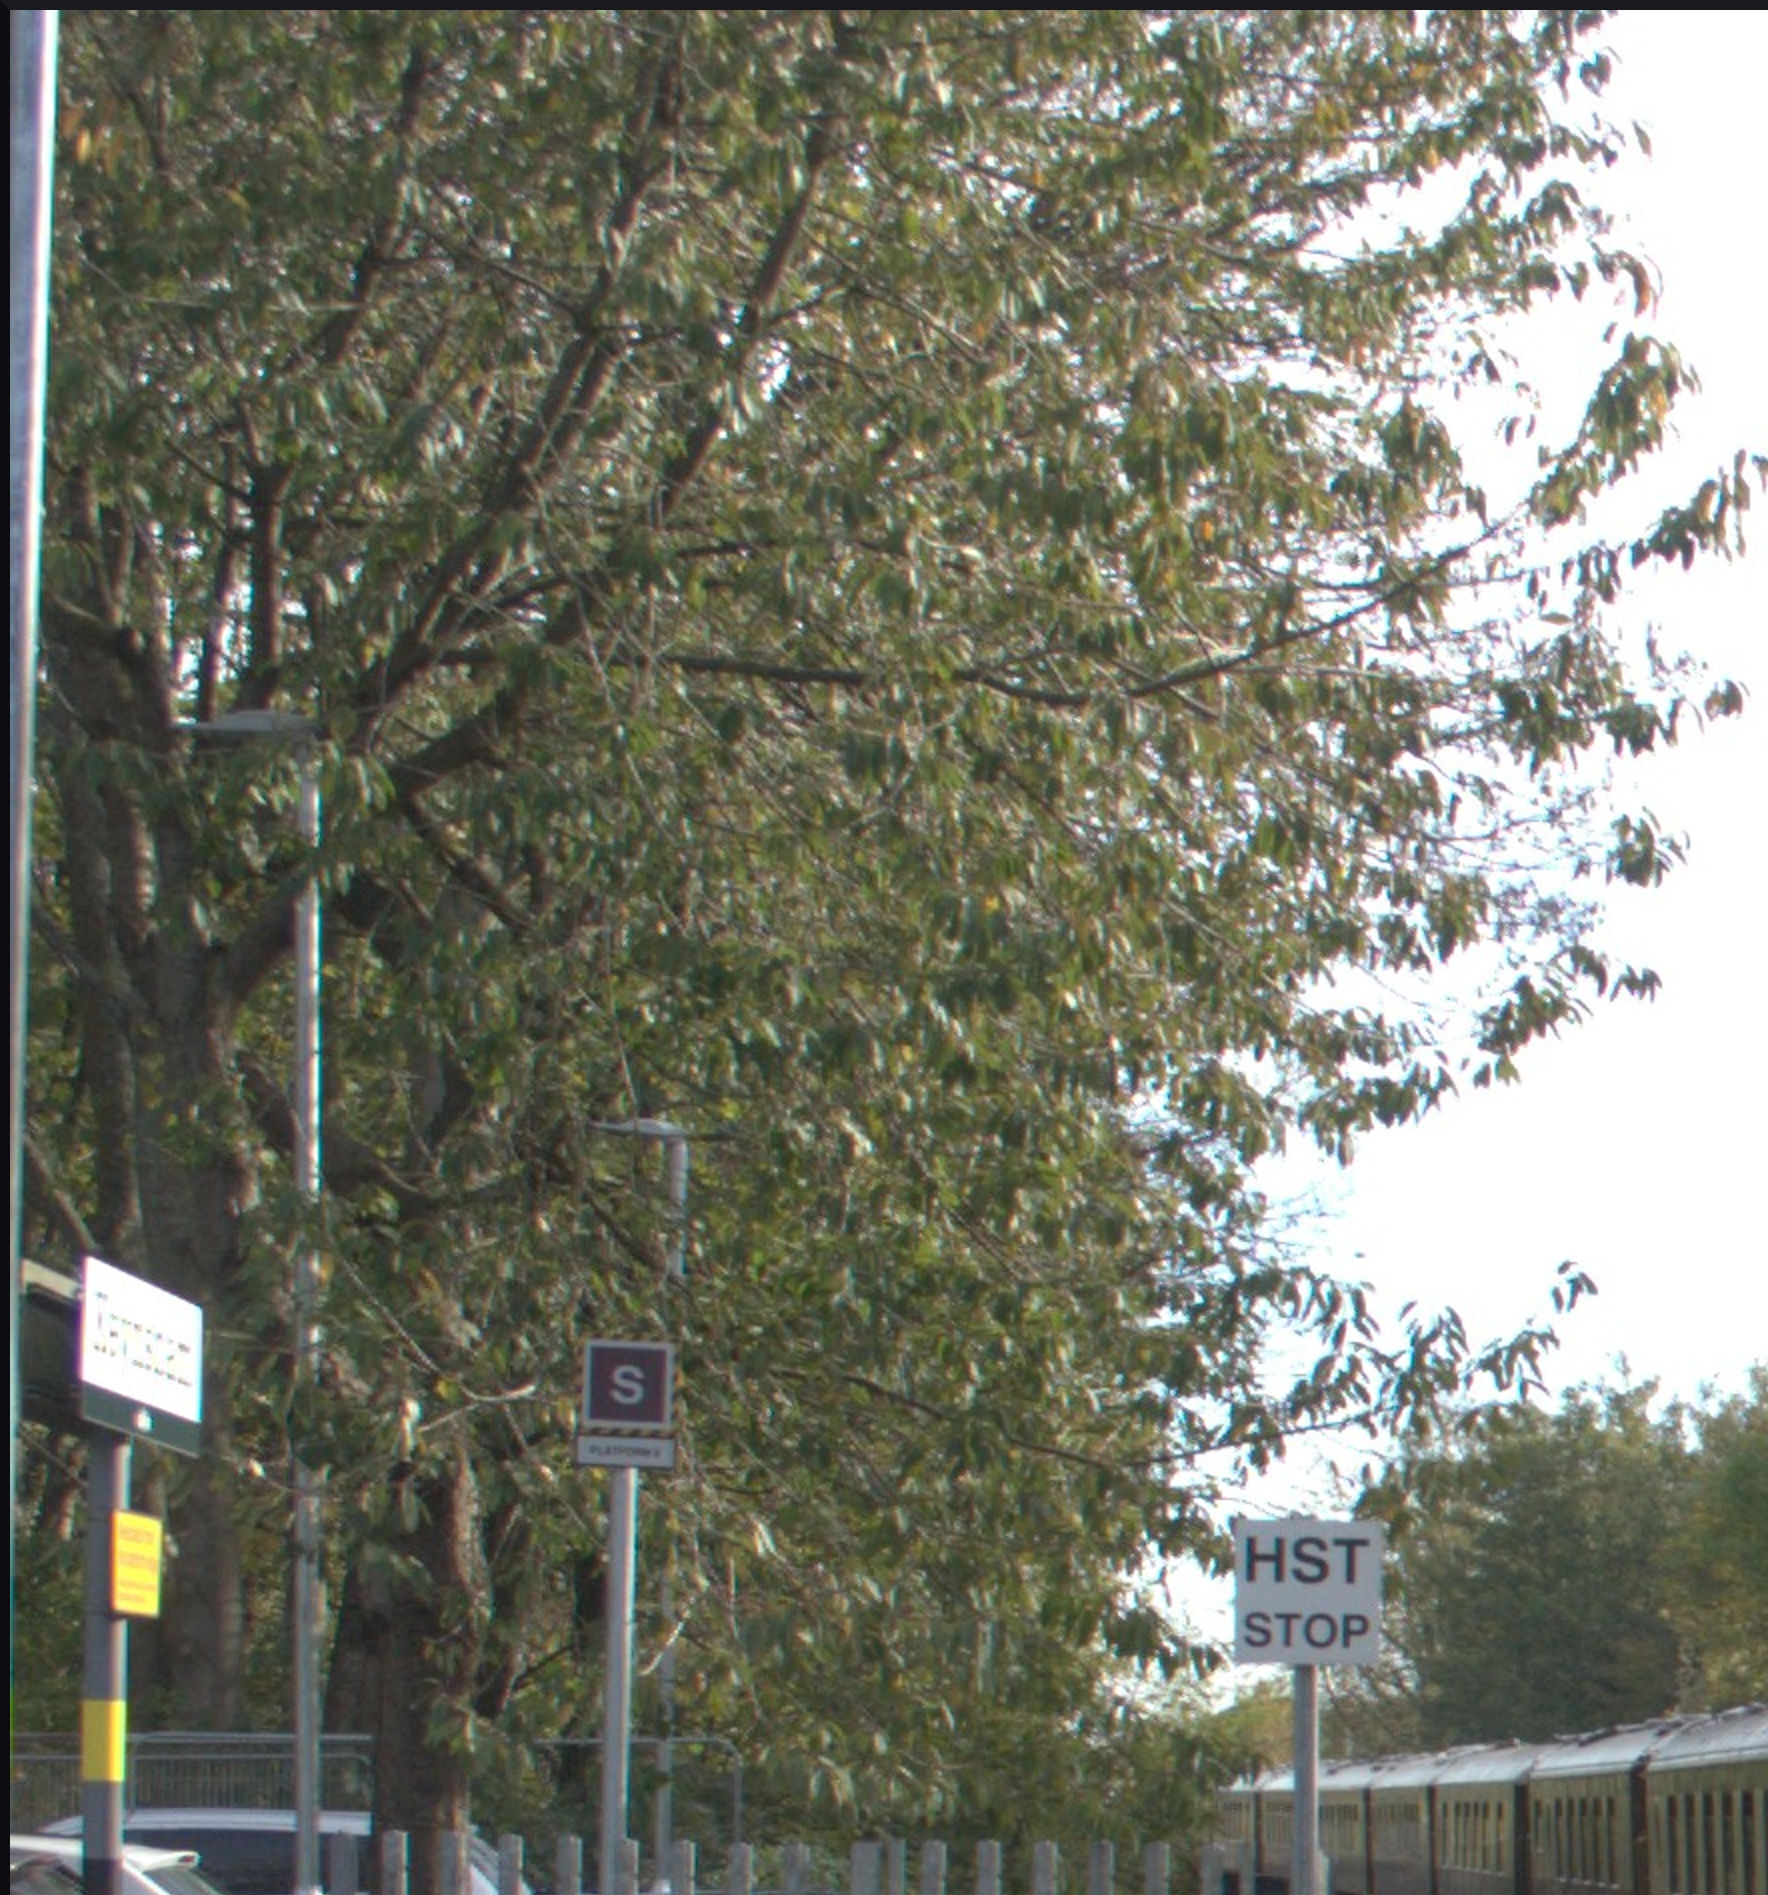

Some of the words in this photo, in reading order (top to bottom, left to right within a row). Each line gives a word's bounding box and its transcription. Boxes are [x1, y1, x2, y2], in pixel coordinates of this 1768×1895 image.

[611, 1365, 645, 1404] S
[1246, 1536, 1370, 1584] HST
[1244, 1612, 1370, 1649] STOP
